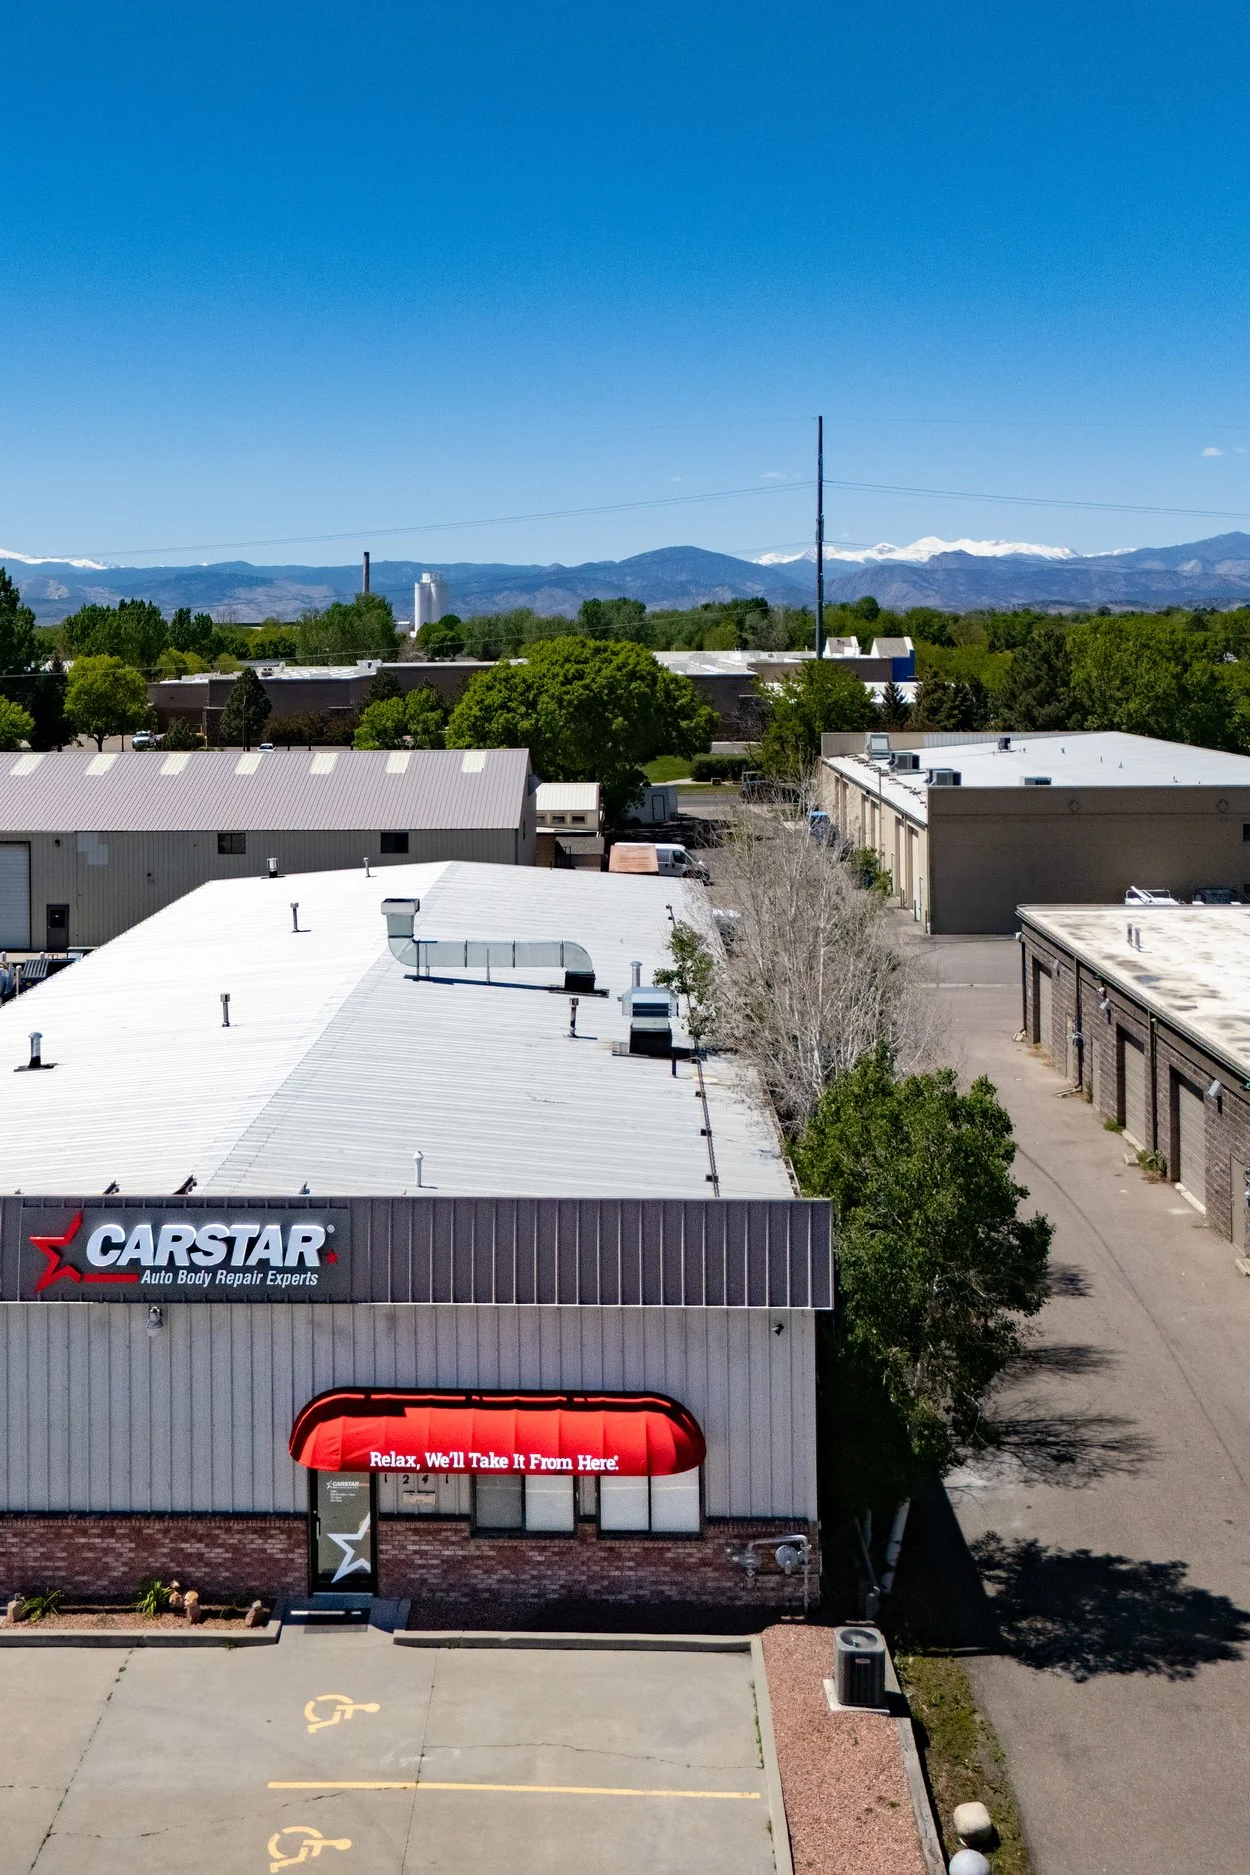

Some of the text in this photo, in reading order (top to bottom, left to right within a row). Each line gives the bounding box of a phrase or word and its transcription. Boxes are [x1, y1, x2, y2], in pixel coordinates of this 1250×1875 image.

[86, 1224, 326, 1267] CARSTAR
[141, 1269, 319, 1288] Auto Body Repair Experts
[369, 1451, 421, 1470] Relax,
[424, 1451, 465, 1468] We'll
[468, 1452, 509, 1468] Take
[513, 1453, 526, 1469] It
[529, 1453, 574, 1470] From
